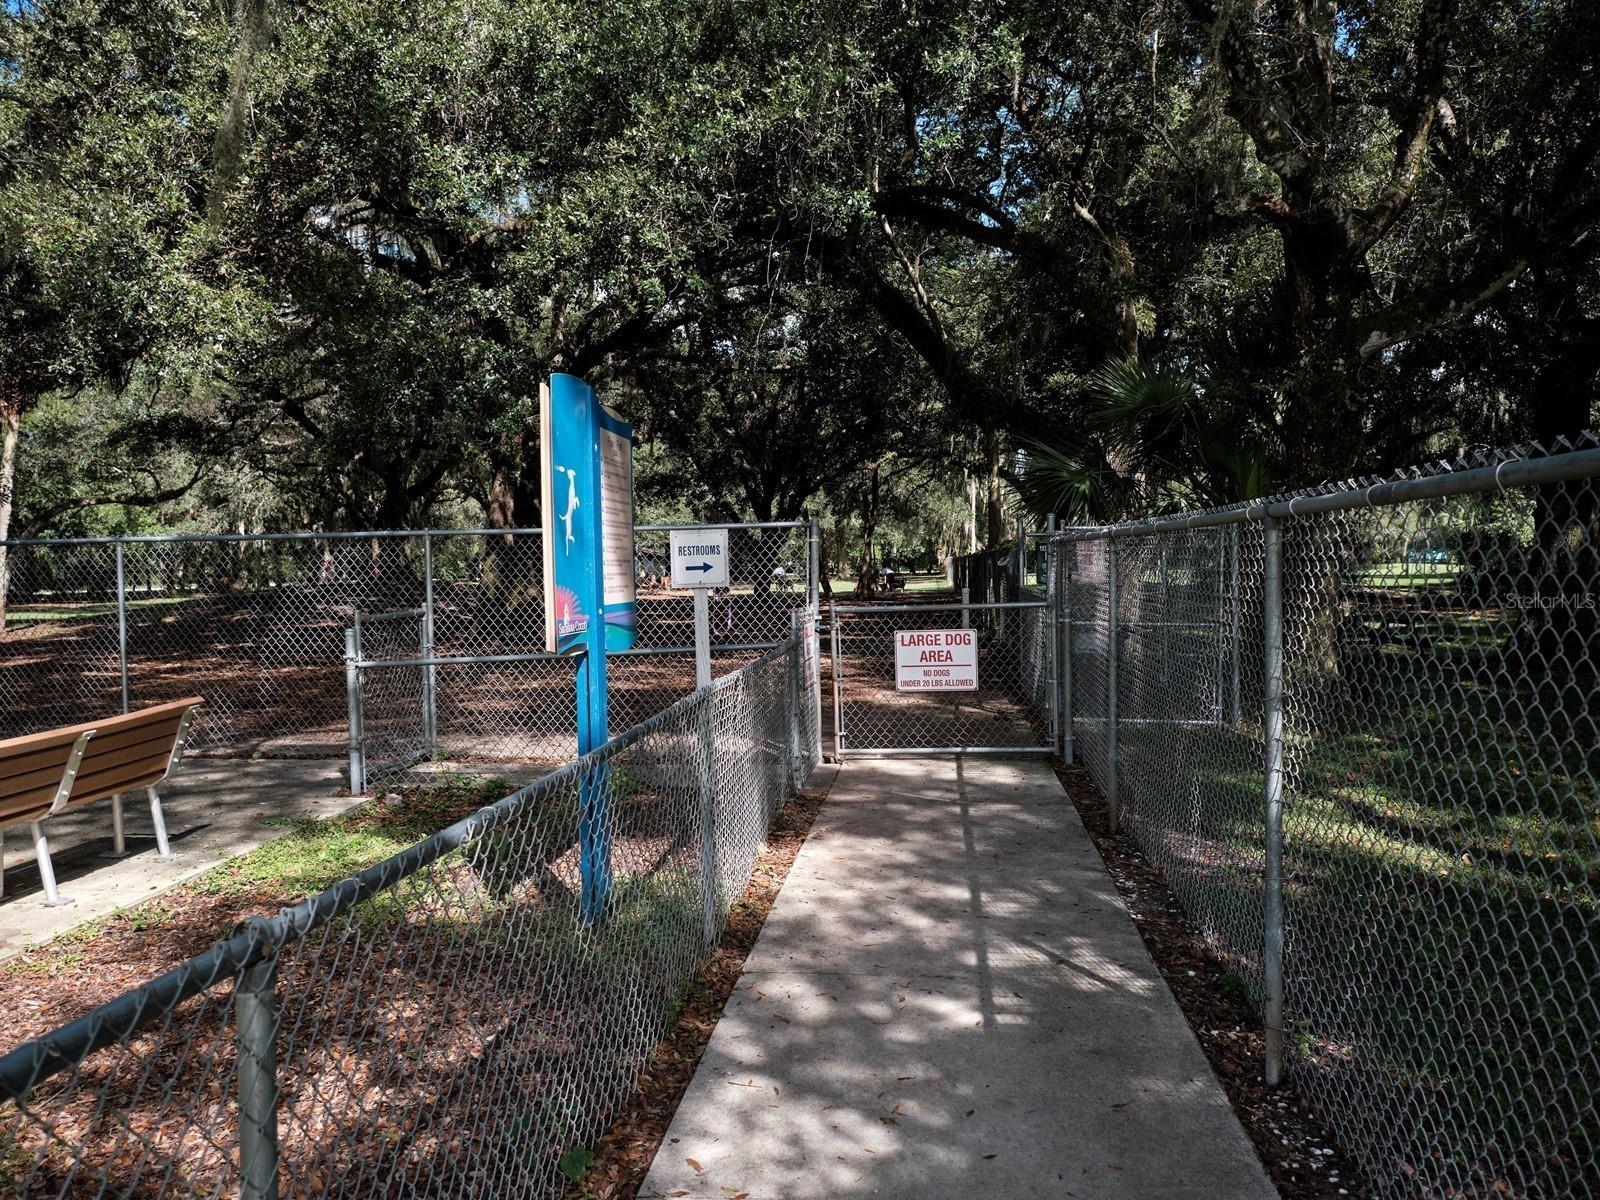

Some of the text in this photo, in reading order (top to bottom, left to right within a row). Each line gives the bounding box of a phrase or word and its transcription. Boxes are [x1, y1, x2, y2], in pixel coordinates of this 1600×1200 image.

[678, 544, 721, 557] RESTROOMS
[901, 633, 971, 647] LARGE DOG
[919, 650, 953, 663] AREA
[923, 669, 951, 677] NO DOGS
[900, 679, 974, 687] UNDER 20 LBS ALLOWED
